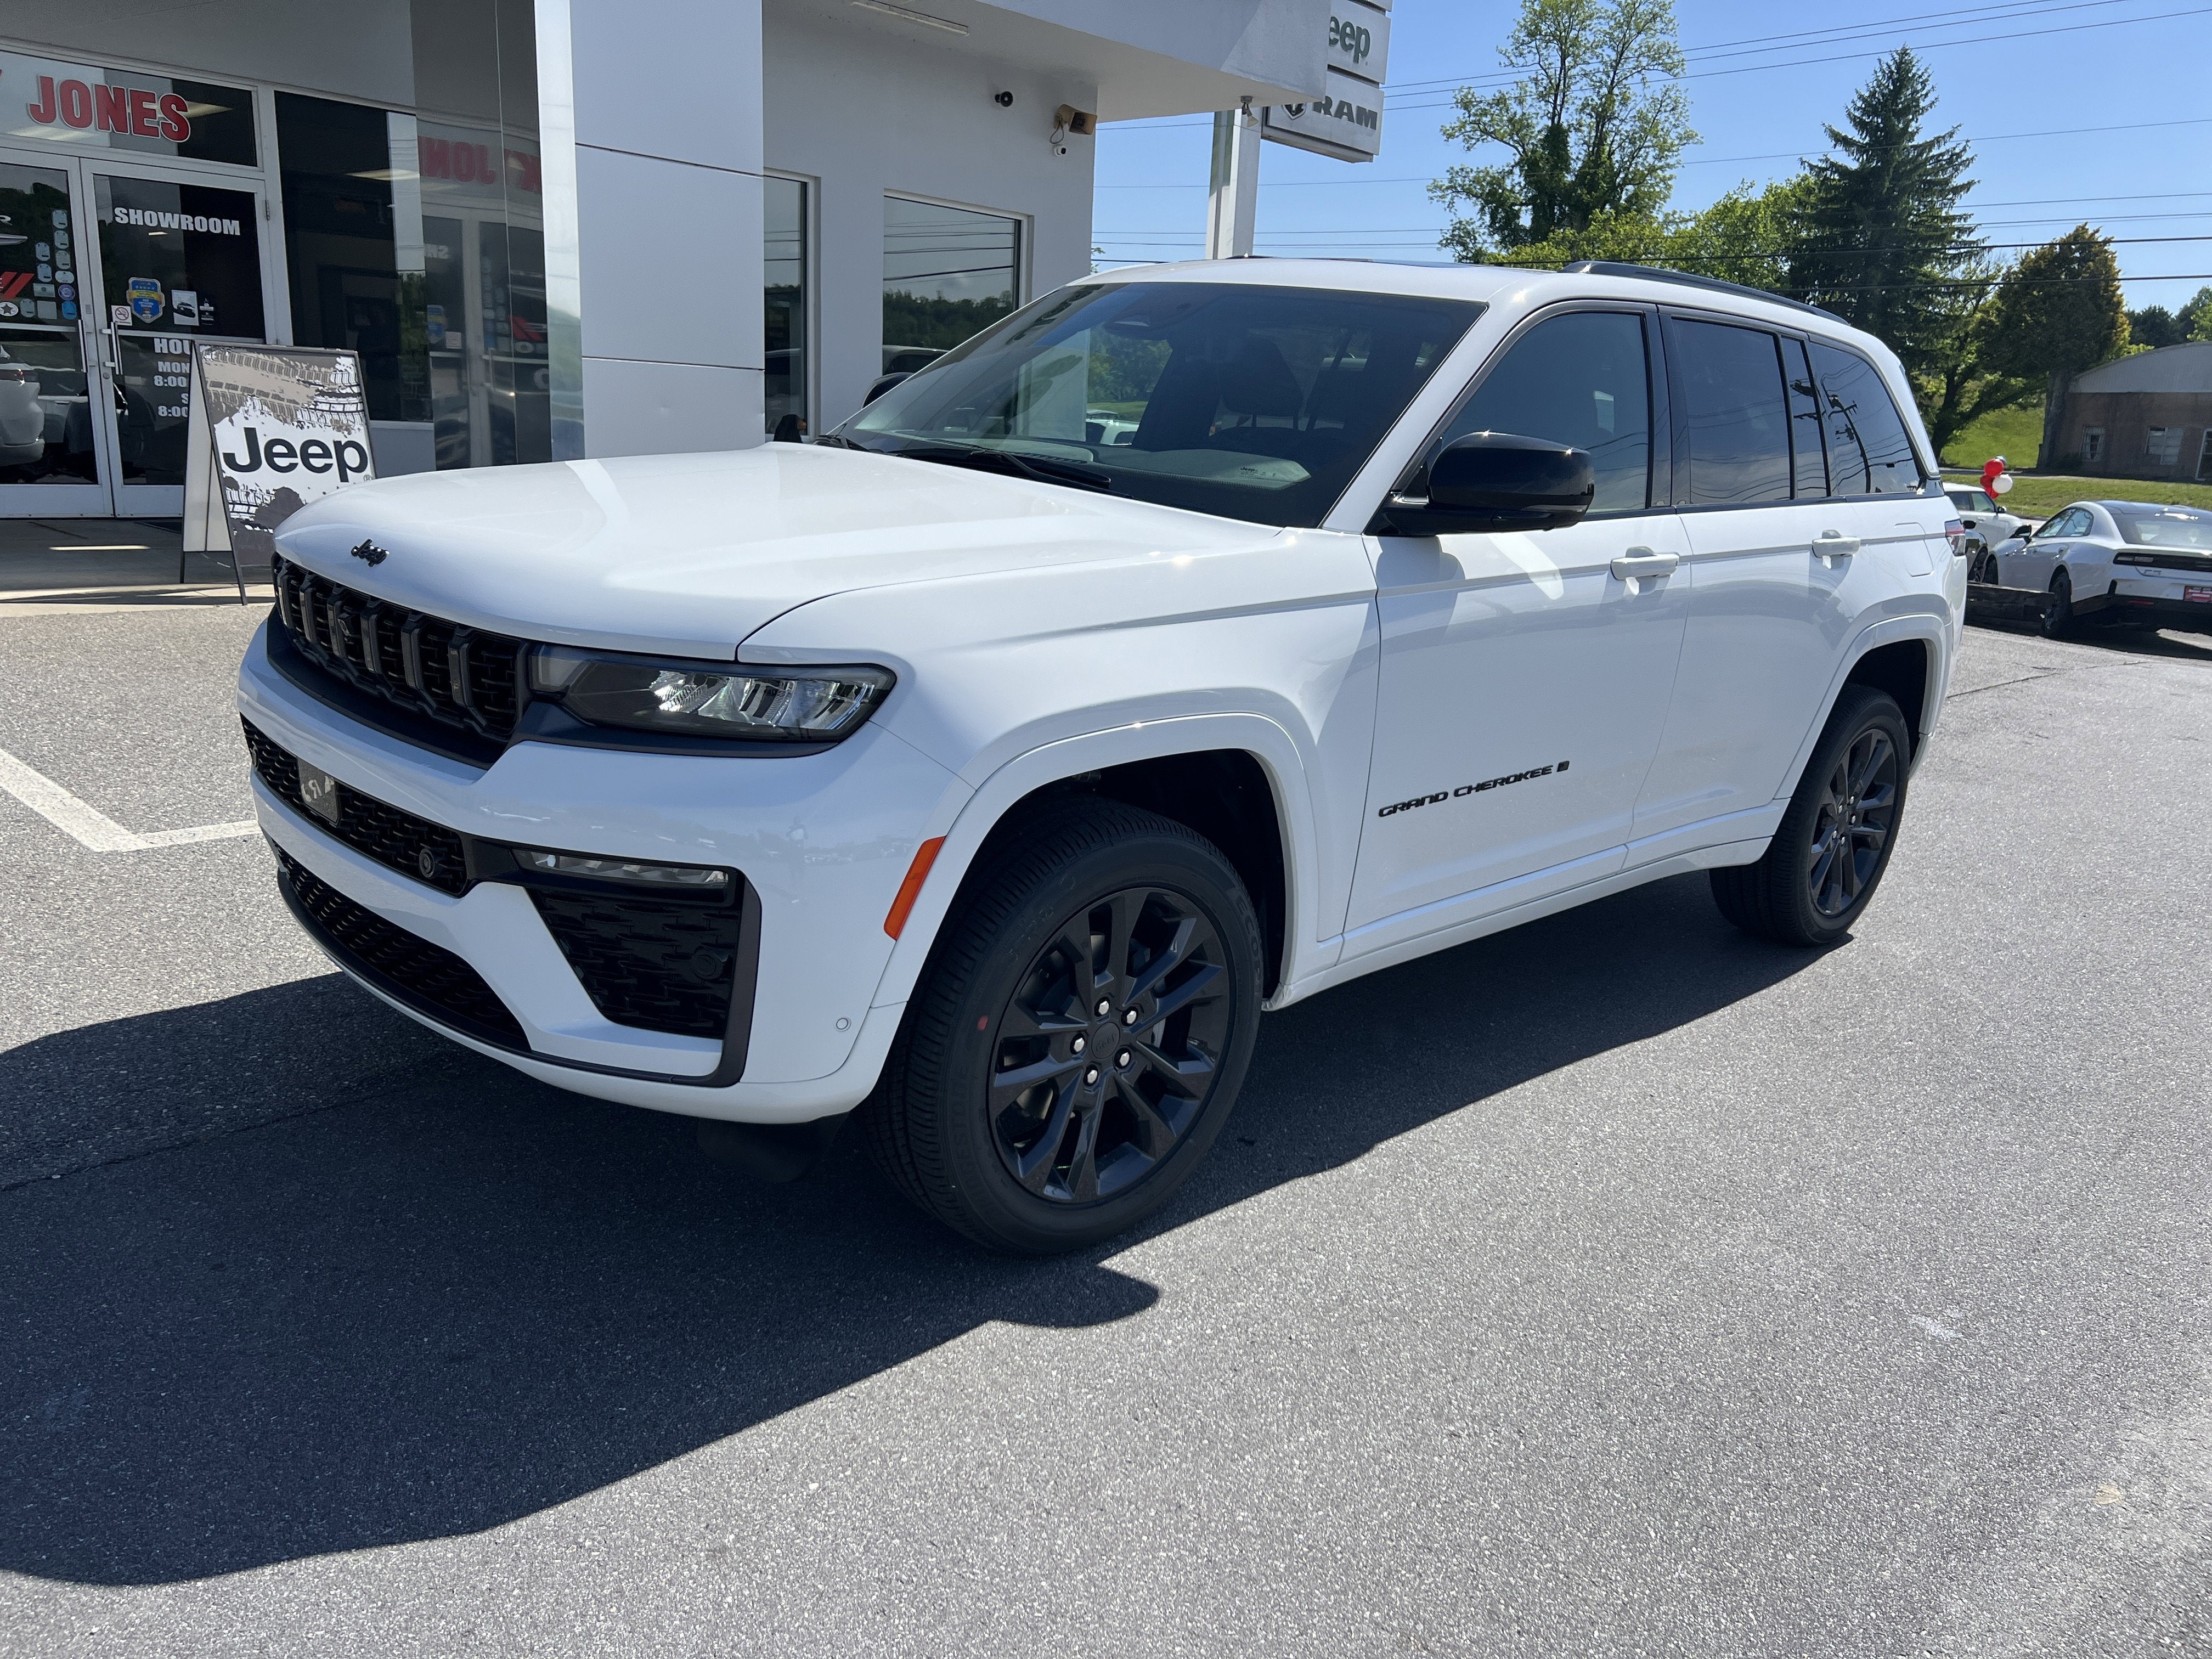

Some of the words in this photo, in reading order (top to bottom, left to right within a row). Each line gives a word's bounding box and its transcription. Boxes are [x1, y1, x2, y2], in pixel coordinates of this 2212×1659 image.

[27, 75, 191, 142] JONES
[1313, 95, 1378, 131] RAM
[114, 207, 241, 235] SHOWROOM
[154, 375, 187, 387] 8:00
[158, 361, 190, 373] MON
[222, 427, 368, 482] Jeep
[1379, 791, 1449, 817] GRAND
[1453, 765, 1554, 797] CHEROKEE
